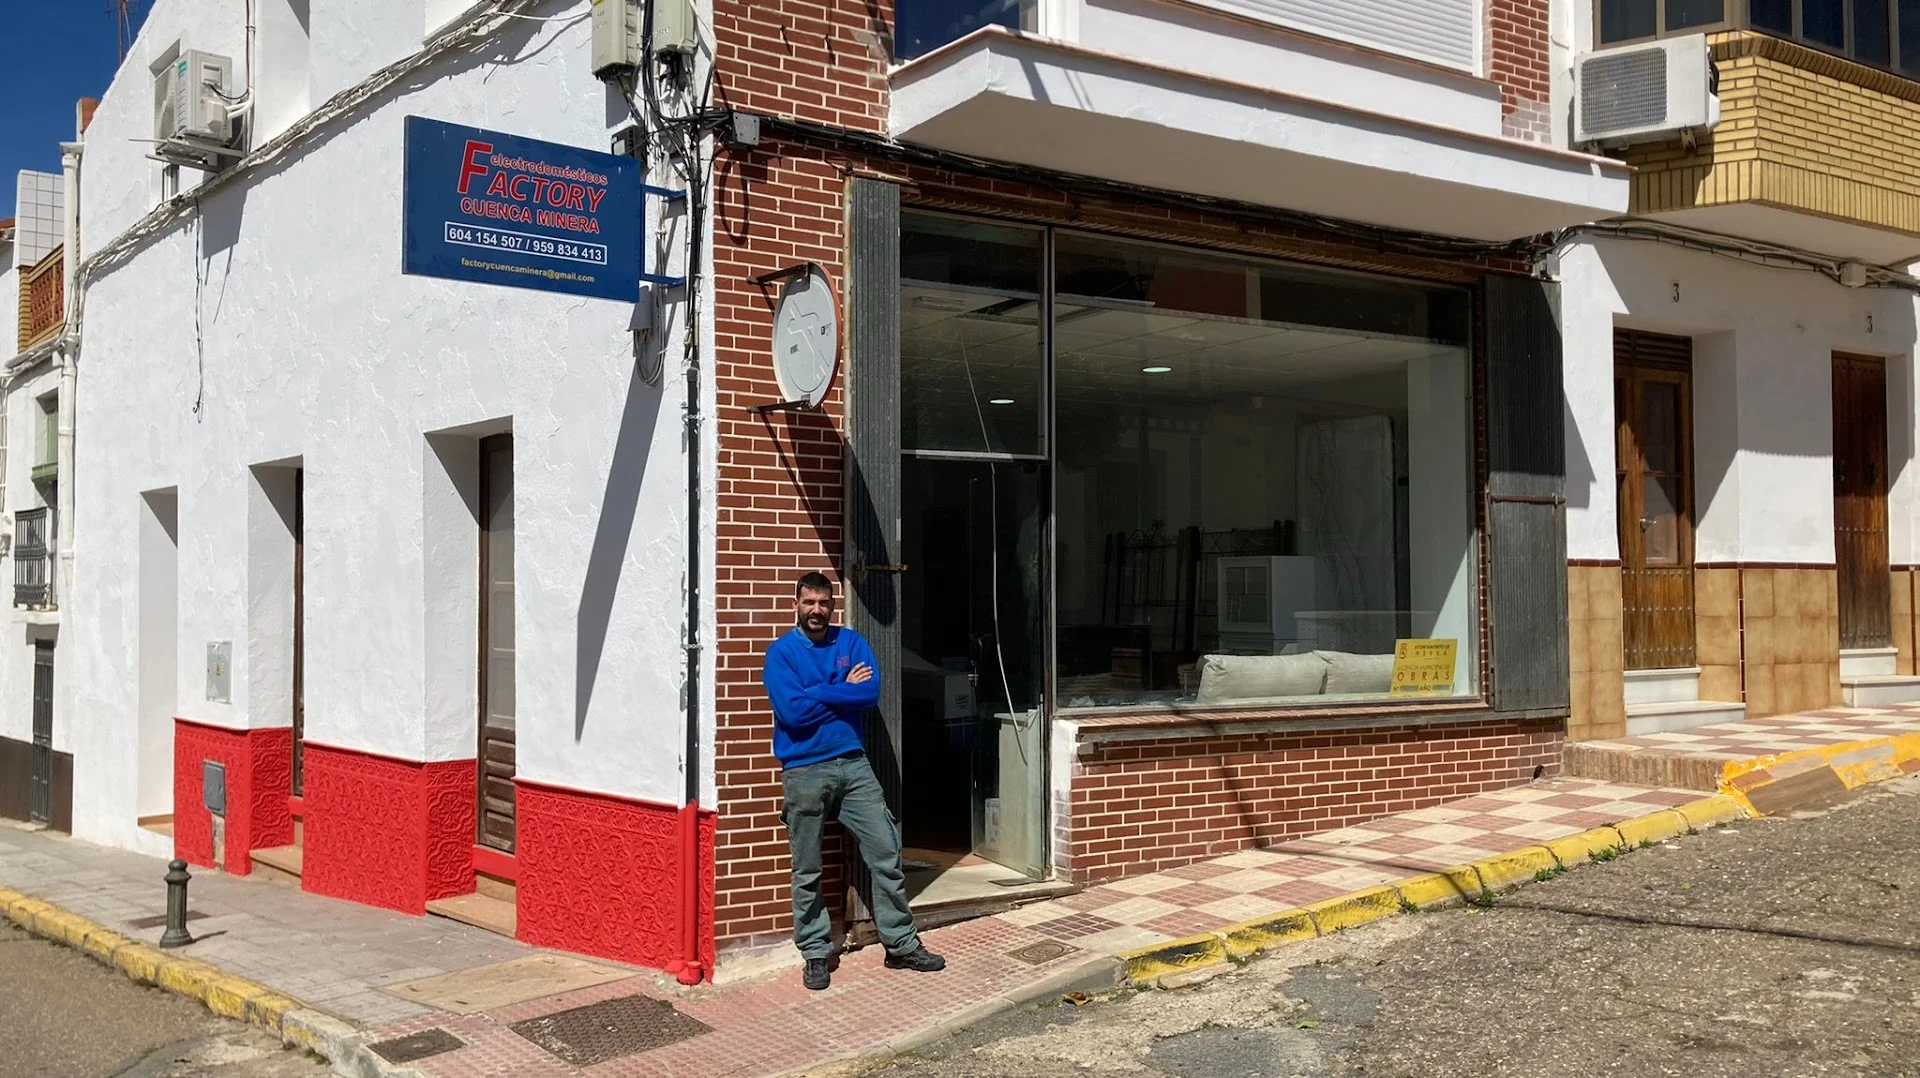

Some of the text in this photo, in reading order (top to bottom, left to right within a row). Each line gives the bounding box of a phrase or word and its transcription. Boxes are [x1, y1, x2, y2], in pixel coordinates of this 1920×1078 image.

[457, 139, 606, 213] FACTORY
[490, 153, 608, 185] electrodomésticos
[460, 196, 600, 234] CUENCA MINERA
[449, 227, 472, 242] 604
[475, 231, 497, 246] 154
[501, 235, 523, 249] 507
[533, 240, 554, 254] 959
[557, 243, 578, 257] 834
[581, 247, 602, 261] 413
[461, 257, 595, 282] factorycuencaminera@gmail.com
[1672, 282, 1680, 303] 3
[1867, 315, 1873, 333] 3
[1397, 671, 1450, 682] OBRAS
